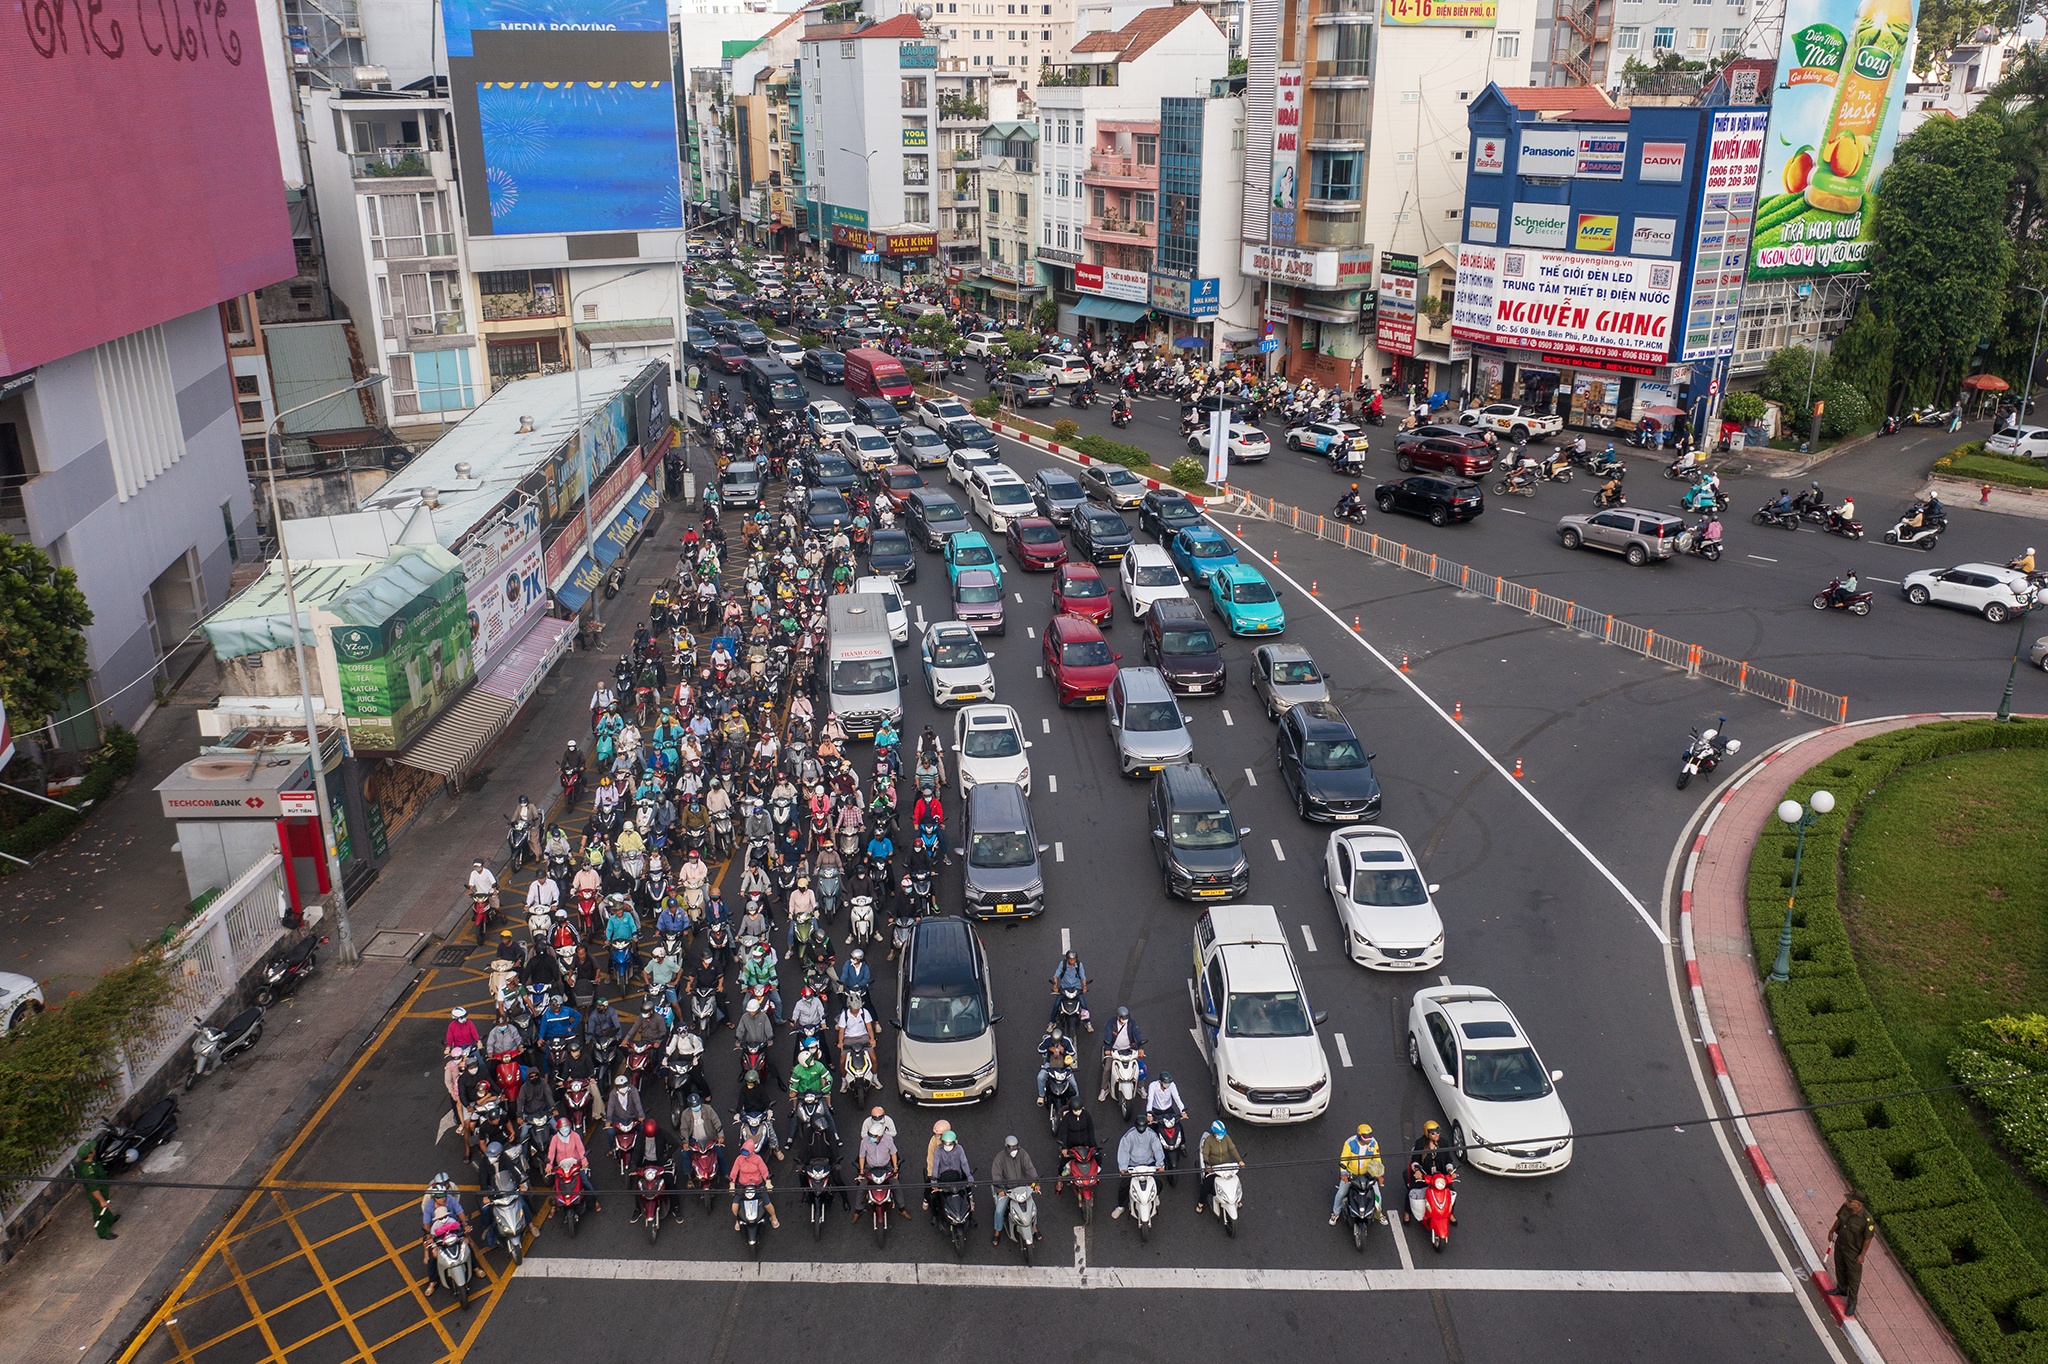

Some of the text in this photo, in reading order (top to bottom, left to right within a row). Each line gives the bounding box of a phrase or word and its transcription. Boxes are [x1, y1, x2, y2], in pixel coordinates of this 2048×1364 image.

[1390, 0, 1432, 17] 14-16
[1436, 5, 1451, 18] ĐIỆN
[1453, 4, 1468, 17] BIÊN
[1486, 7, 1496, 17] Q.1
[1805, 29, 1842, 48] Diện Mạo
[1802, 43, 1840, 67] Mới
[920, 58, 936, 67] SPA
[1857, 51, 1889, 75] Cozy
[1802, 69, 1822, 83] không
[1823, 71, 1836, 83] đổi
[1858, 90, 1871, 101] Trà
[1278, 105, 1299, 126] HOÀI
[1839, 102, 1861, 119] Đào
[1714, 113, 1730, 132] THIẾT
[1737, 114, 1751, 134] ĐIỆN
[1278, 133, 1296, 150] ANH
[1594, 142, 1621, 151] LION
[1522, 146, 1575, 158] Panasonic
[1740, 139, 1762, 159] GIANG
[1589, 163, 1621, 171] DAPHACO
[1643, 157, 1681, 166] CADIVI
[1710, 164, 1757, 175] 0906 679 300
[1708, 175, 1756, 187] 0909 209 300
[1470, 220, 1496, 229] SENKO
[1514, 215, 1566, 229] Schneider
[1781, 212, 1861, 242] TRÀ HOA QUẢ
[1535, 227, 1564, 236] Electric
[1581, 226, 1613, 236] MPE
[1634, 228, 1671, 240] anfaco
[890, 234, 933, 247] MẮT KÍNH
[1702, 235, 1723, 244] MPE
[1287, 249, 1301, 259] VIỆN
[1542, 254, 1633, 267] www.nguyengiang.vn
[1725, 255, 1740, 266] LS
[1760, 243, 1846, 266] NGON RÕ VỊ VỊ RÕ
[1253, 254, 1313, 276] HOÀI ANH
[1460, 251, 1496, 271] ĐÈN CHIẾU SÁNG
[1340, 261, 1372, 275] HOÀI ANH
[1540, 264, 1633, 283] THẾ GIỚI ĐÈN LED
[1503, 279, 1670, 304] TRUNG TÂM THIẾT BỊ ĐIỆN NƯỚC
[1363, 303, 1374, 311] QUY
[1694, 299, 1714, 307] APOLLO
[1496, 298, 1668, 337] NGUYỄN GIANG
[1379, 327, 1412, 343] HÒA PHÁT
[1453, 329, 1491, 341] www.nguyengiang.vn
[1496, 324, 1663, 349] ĐC: Số 08 Điện Biên Phủ, Kao, Q.1, TP.HCM
[1688, 334, 1709, 342] TOTAL
[1496, 336, 1520, 345] HOTLINE:
[1580, 345, 1594, 354] 0906
[1595, 347, 1606, 356] 679
[1607, 348, 1619, 357] 300
[1622, 350, 1637, 359] 0906
[1638, 352, 1650, 360] 819
[1651, 353, 1663, 362] 300
[1606, 363, 1622, 372] ĐIỆN
[1641, 367, 1654, 375] TAY
[1674, 367, 1687, 378] Số 08
[1641, 383, 1668, 392] MPE
[524, 508, 538, 534] 7K
[522, 567, 543, 606] 7K
[346, 643, 359, 651] YZ
[348, 664, 374, 672] COFFEE
[168, 799, 242, 807] TECHCOMBANK
